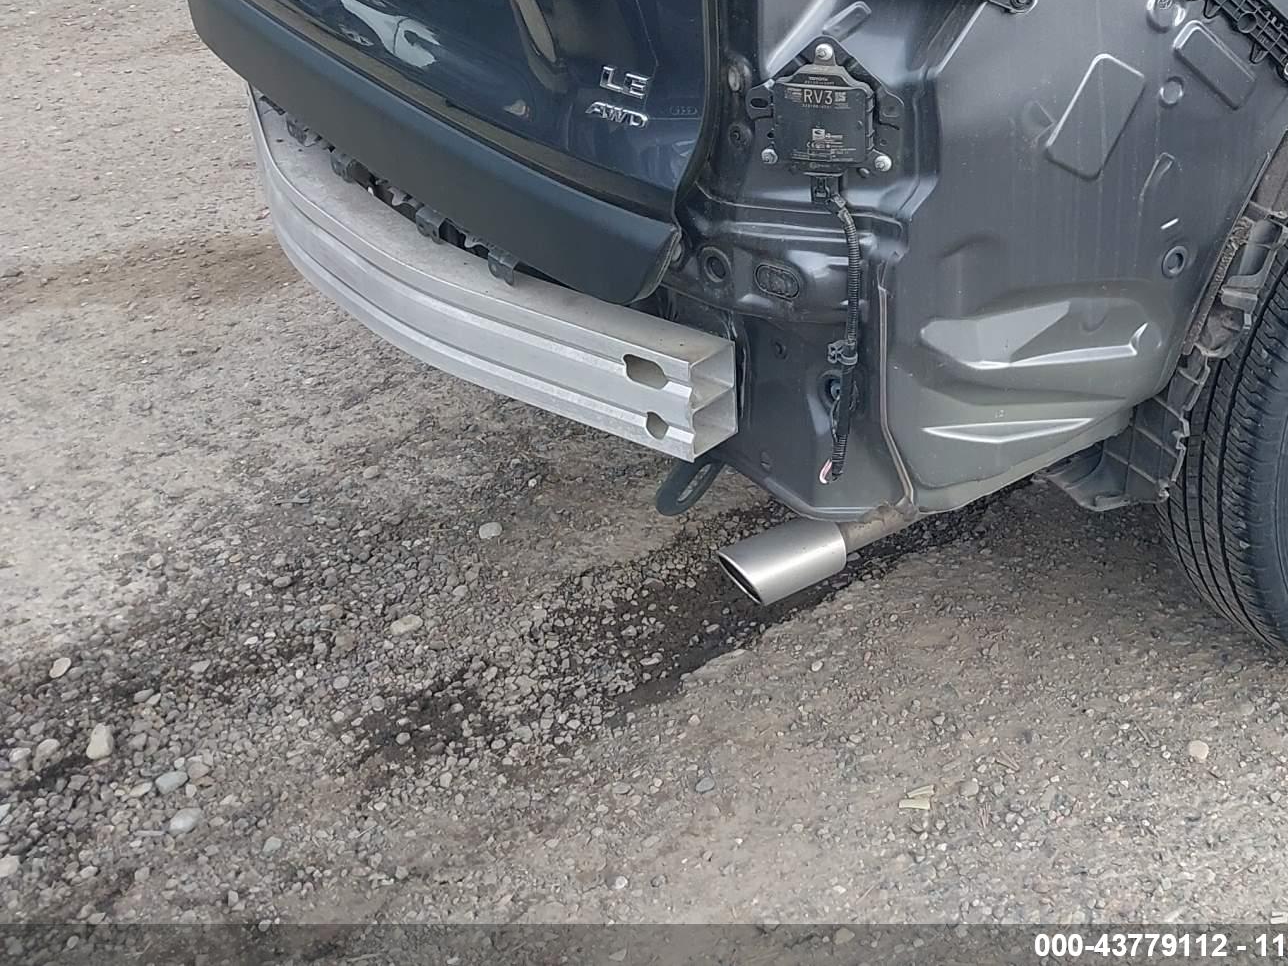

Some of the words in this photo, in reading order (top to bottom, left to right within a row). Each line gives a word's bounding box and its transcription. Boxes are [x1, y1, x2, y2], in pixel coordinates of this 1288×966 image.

[600, 65, 649, 100] LE
[803, 89, 833, 105] RV3
[585, 101, 649, 129] AWD
